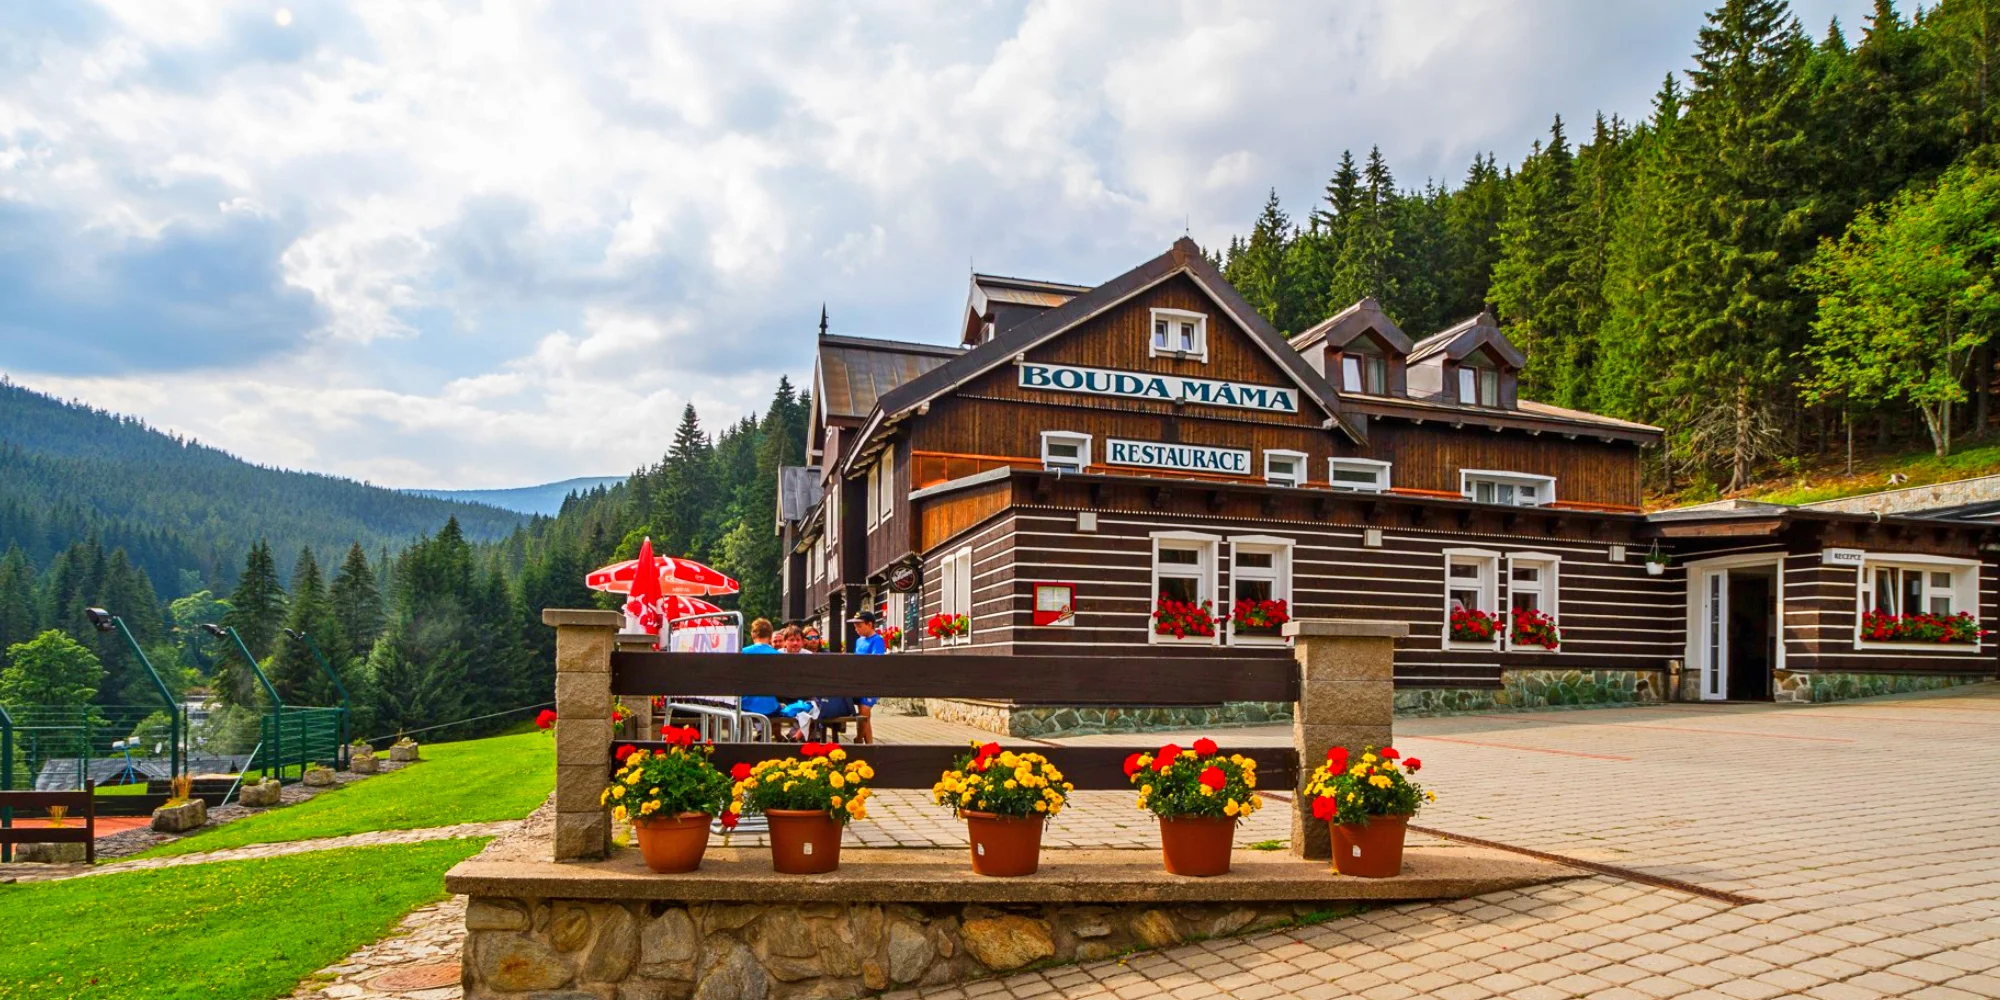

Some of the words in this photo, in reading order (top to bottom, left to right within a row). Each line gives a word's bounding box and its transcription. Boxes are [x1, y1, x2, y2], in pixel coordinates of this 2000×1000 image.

[1022, 365, 1172, 398] BOUDA
[1181, 382, 1295, 410] MÁMA
[1112, 442, 1246, 471] RESTAURACE
